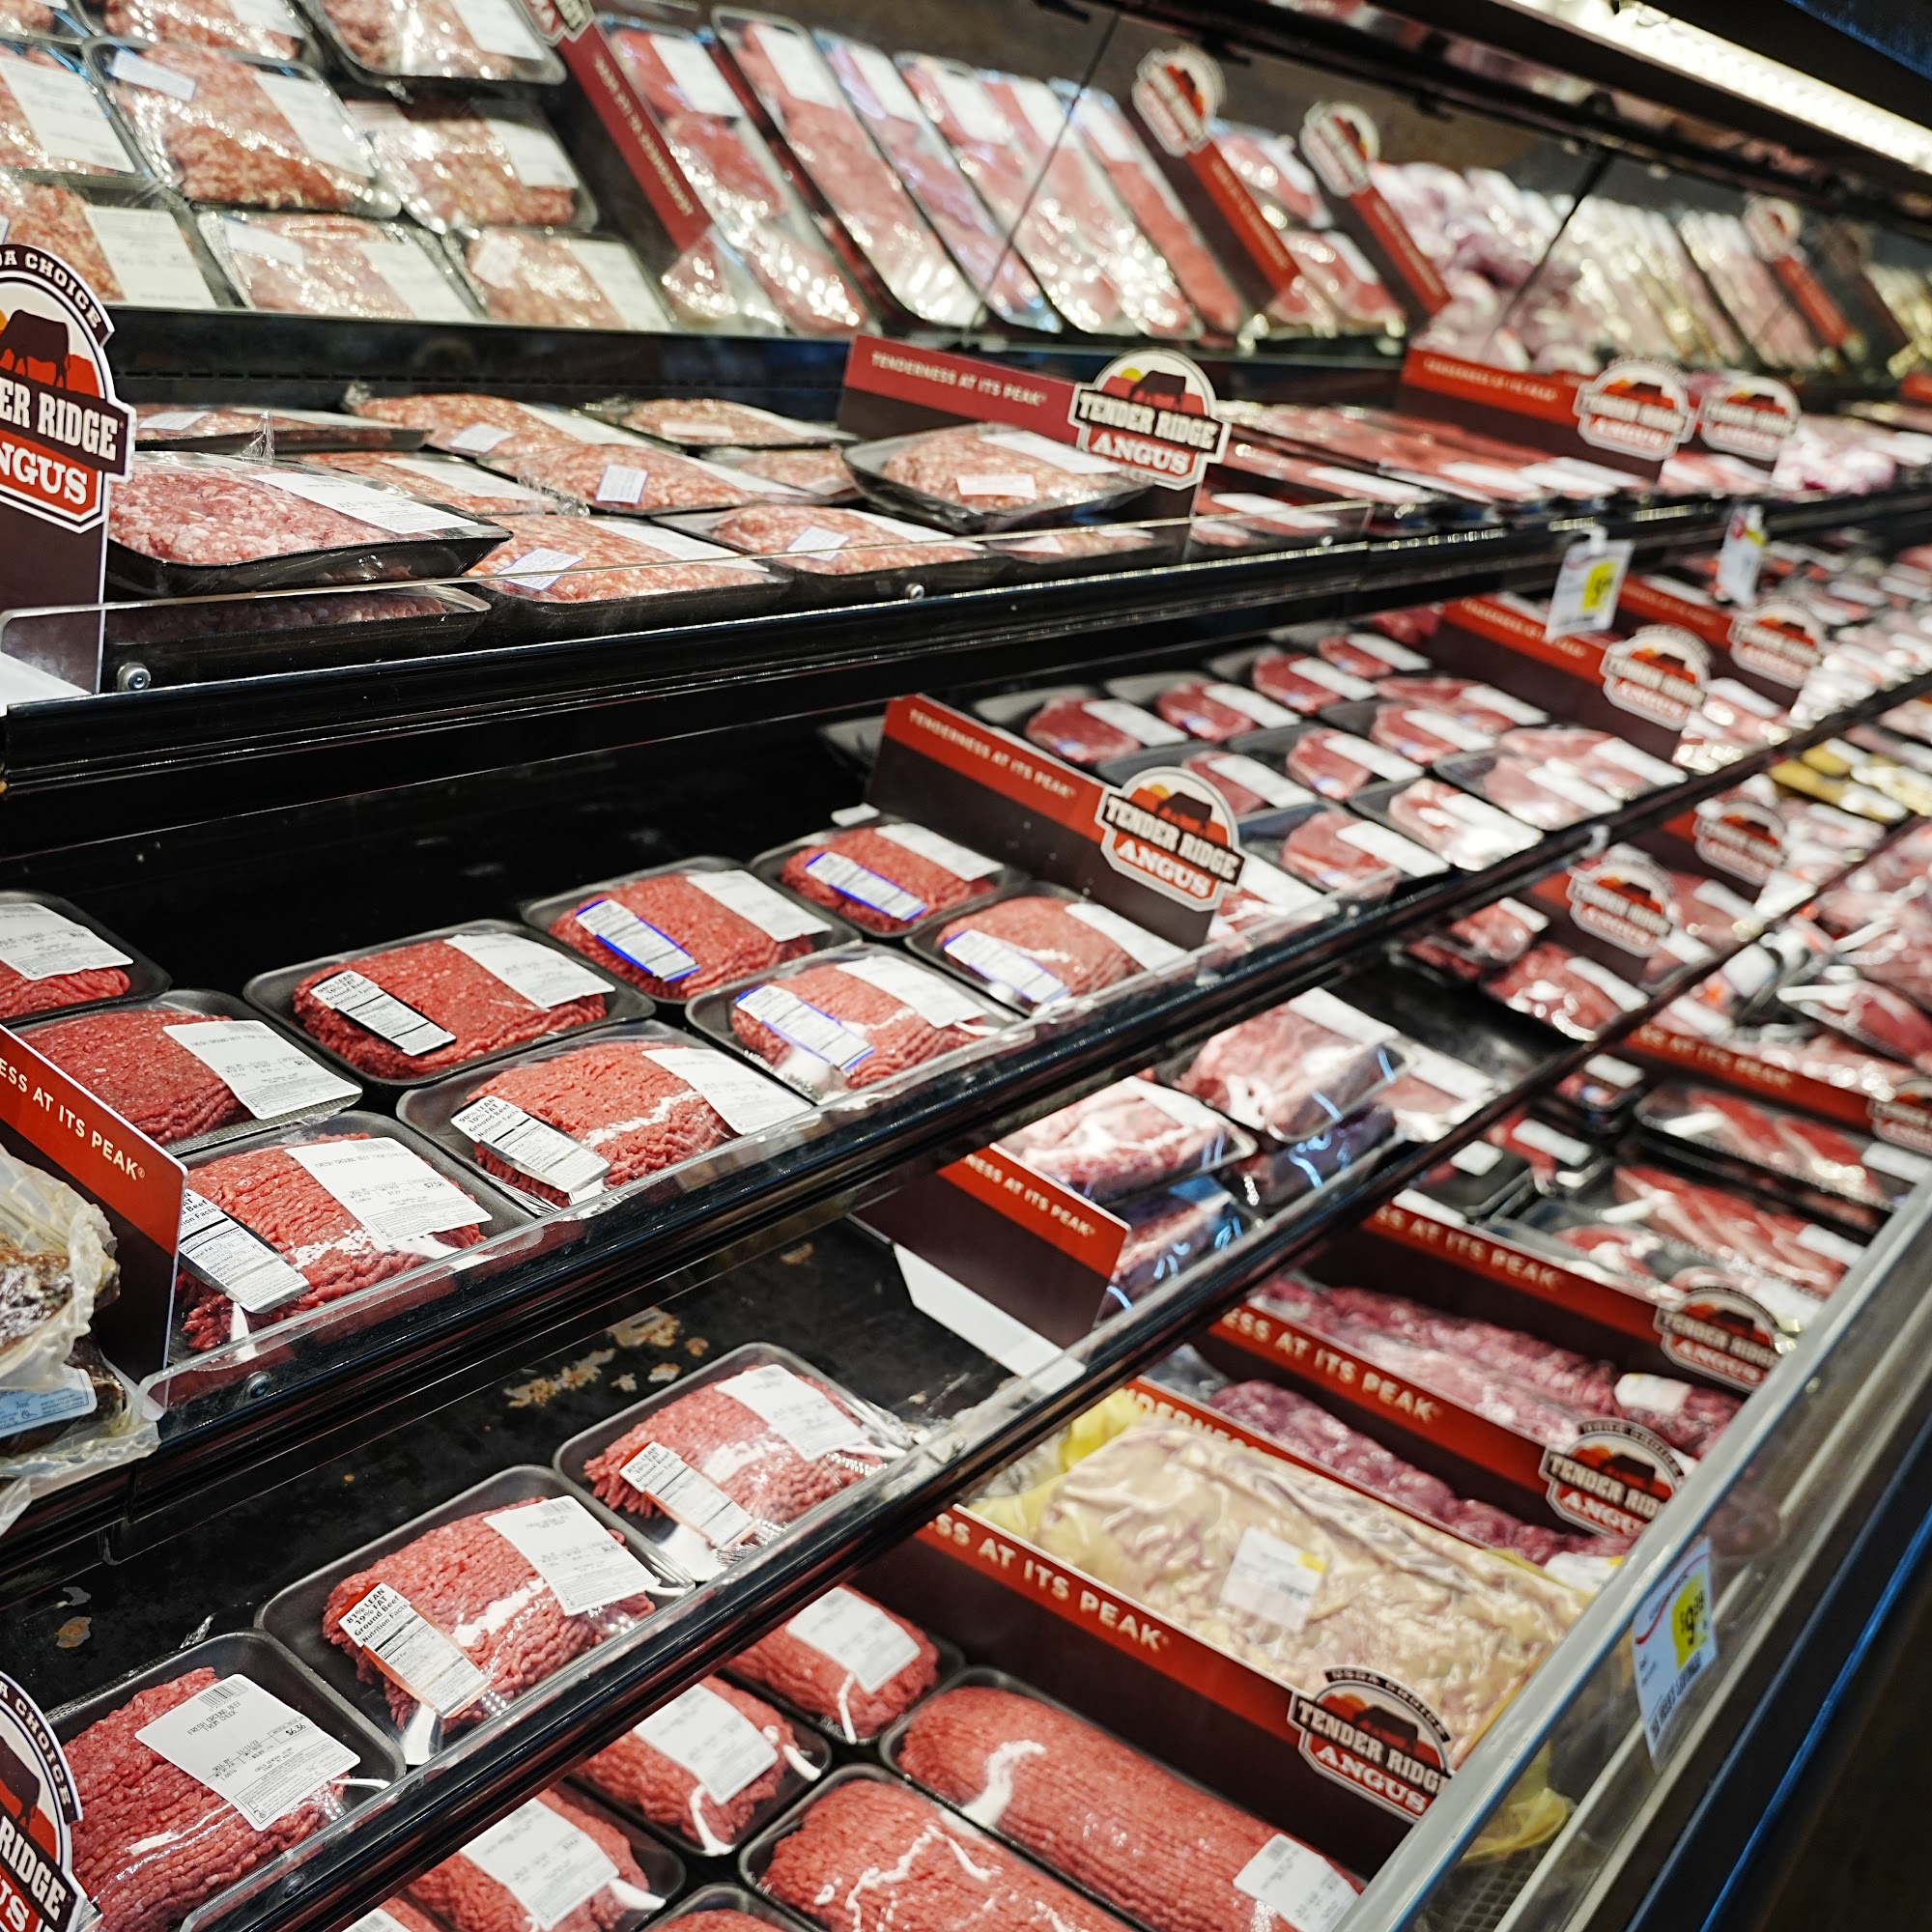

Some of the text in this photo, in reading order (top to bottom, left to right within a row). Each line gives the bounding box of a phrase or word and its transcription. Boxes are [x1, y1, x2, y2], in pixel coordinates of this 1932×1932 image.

[25, 252, 101, 328] CHOICE
[871, 351, 957, 385] TENDERNESS
[958, 372, 979, 389] AT
[978, 378, 1002, 397] ITS
[1079, 391, 1219, 450] TENDER RIDGE
[1092, 432, 1190, 474] ANGUS
[909, 708, 991, 759] TENDERNESS
[990, 750, 1010, 767] AT
[1009, 758, 1034, 781] ITS
[1105, 795, 1240, 881] TENDER RIDGE
[1116, 839, 1211, 897] ANGUS
[32, 1086, 54, 1112] AT
[59, 1105, 86, 1138] ITS
[459, 1098, 496, 1122] 90% LEAN
[469, 1103, 498, 1123] 10% FAT
[469, 1103, 510, 1132] Ground Beef
[477, 1107, 520, 1138] Nutrition Facts
[962, 1153, 1003, 1183] NESS
[1004, 1177, 1025, 1195] AT
[1024, 1188, 1050, 1211] ITS
[186, 1200, 208, 1211] Beef
[195, 1208, 217, 1218] Facts
[191, 1250, 206, 1261] Total
[206, 1254, 234, 1272] Cholesterol
[1274, 1331, 1311, 1359] AT
[1314, 1349, 1357, 1385] ITS
[1362, 1371, 1436, 1424] PEAK
[1550, 1457, 1626, 1506] TENDER
[926, 1513, 971, 1546] SS
[978, 1537, 1016, 1569] AT
[1024, 1559, 1071, 1601] ITS
[346, 1588, 384, 1624] 81% LEAN
[353, 1596, 387, 1625] 19% FAT
[354, 1595, 400, 1636] Ground Beef
[361, 1602, 408, 1643] Nutrition Facts
[186, 1700, 242, 1736] FRESH GROUND BEEF
[201, 1718, 220, 1732] FROM
[285, 1723, 306, 1736] $6.36
[1298, 1700, 1384, 1764] TENDER
[14, 1697, 71, 1805] CHOICE
[1316, 1745, 1428, 1813] ANGUS
[1, 1814, 68, 1921] RIDGE
